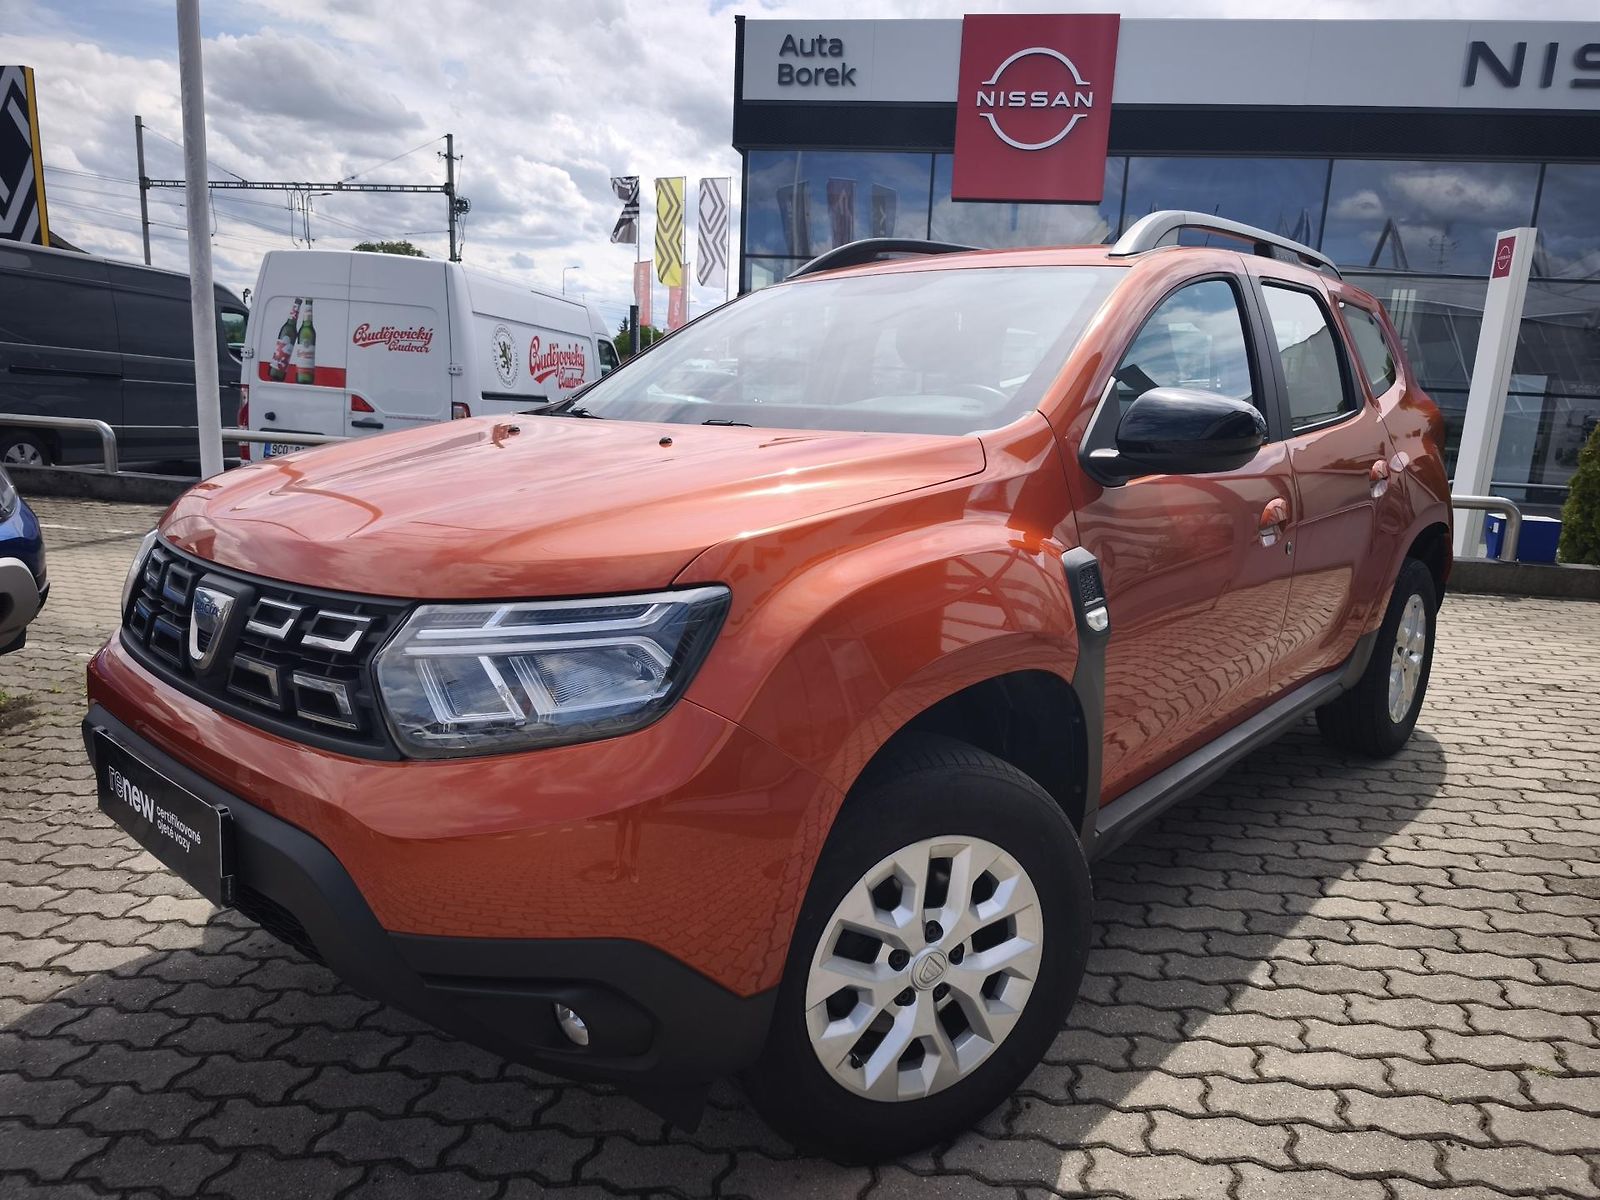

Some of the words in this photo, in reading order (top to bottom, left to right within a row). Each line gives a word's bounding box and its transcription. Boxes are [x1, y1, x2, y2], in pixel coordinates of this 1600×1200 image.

[779, 34, 843, 57] Auta
[777, 62, 857, 87] Borek
[976, 91, 1093, 108] NISSAN
[108, 765, 154, 823] renew
[156, 806, 201, 844] certifikované
[174, 831, 191, 853] vozy
